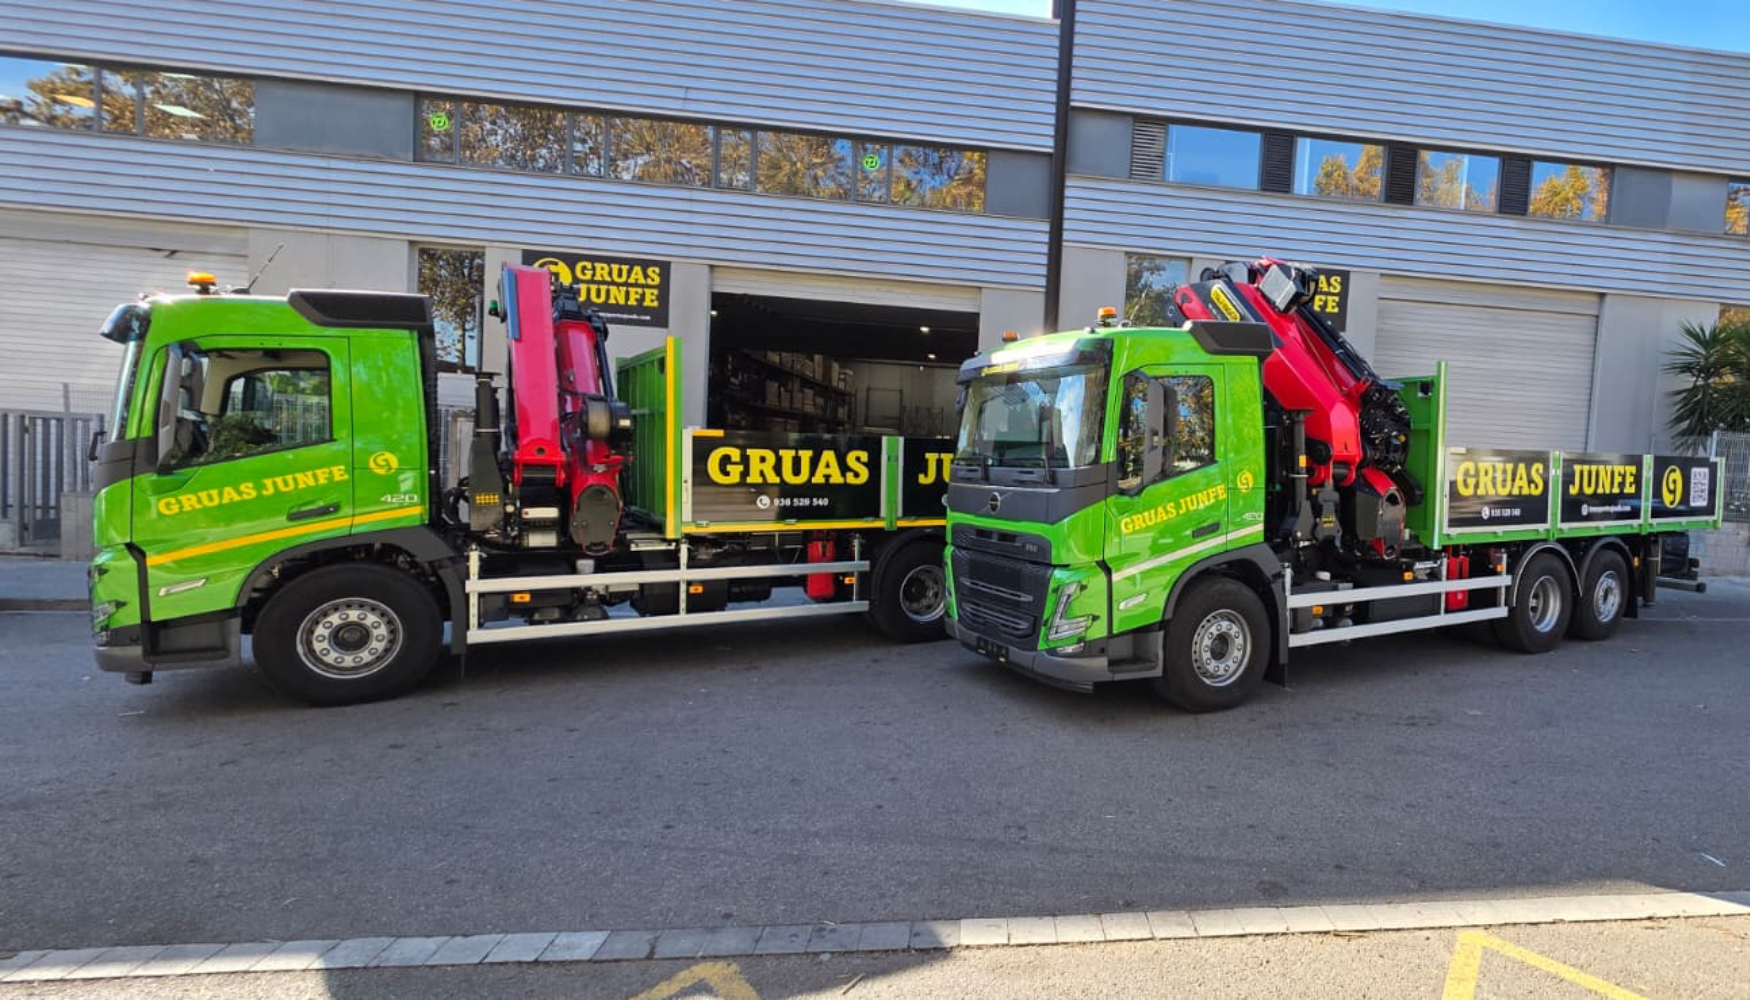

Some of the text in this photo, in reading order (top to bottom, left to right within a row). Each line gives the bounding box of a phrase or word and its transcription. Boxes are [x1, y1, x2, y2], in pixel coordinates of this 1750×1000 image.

[574, 260, 661, 286] GRUAS
[578, 284, 660, 307] JUNFE
[706, 446, 870, 485] GRUAS
[1456, 461, 1637, 498] GRUAS JUNFE
[157, 465, 349, 517] GRUAS JUNFE
[380, 494, 418, 503] 420
[1121, 484, 1227, 533] GRUAS JUNFE
